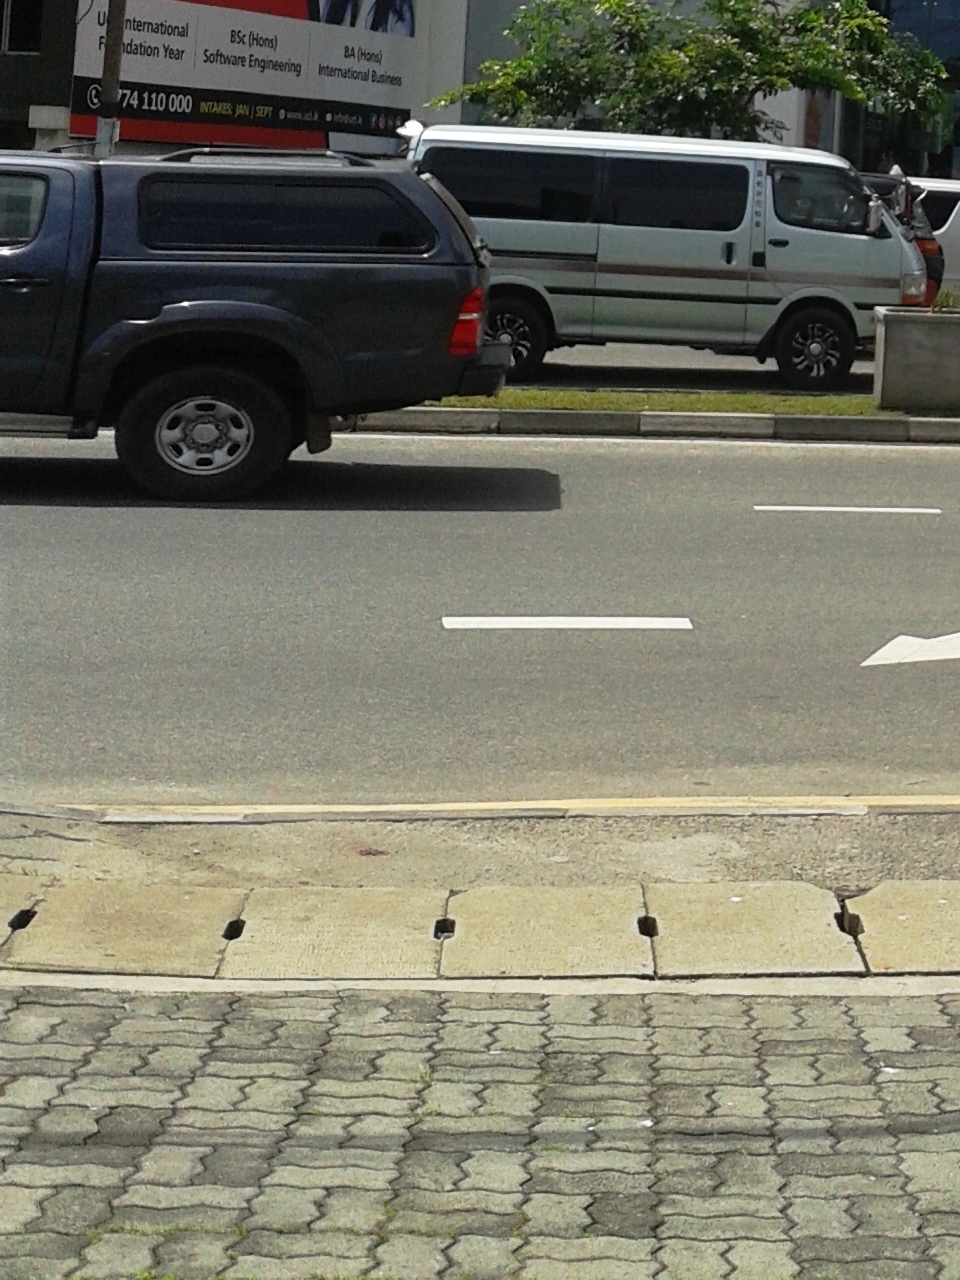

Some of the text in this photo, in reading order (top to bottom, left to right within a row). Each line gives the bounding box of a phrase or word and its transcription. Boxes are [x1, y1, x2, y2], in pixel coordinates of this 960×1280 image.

[122, 16, 189, 38] nternational
[98, 35, 186, 61] Fdation Year
[230, 29, 278, 52] BSc (Hons)
[203, 49, 302, 77] Software Engineering
[344, 45, 383, 66] BA (Hons)
[318, 63, 370, 82] International
[142, 91, 167, 111] 110
[169, 93, 193, 113] 000
